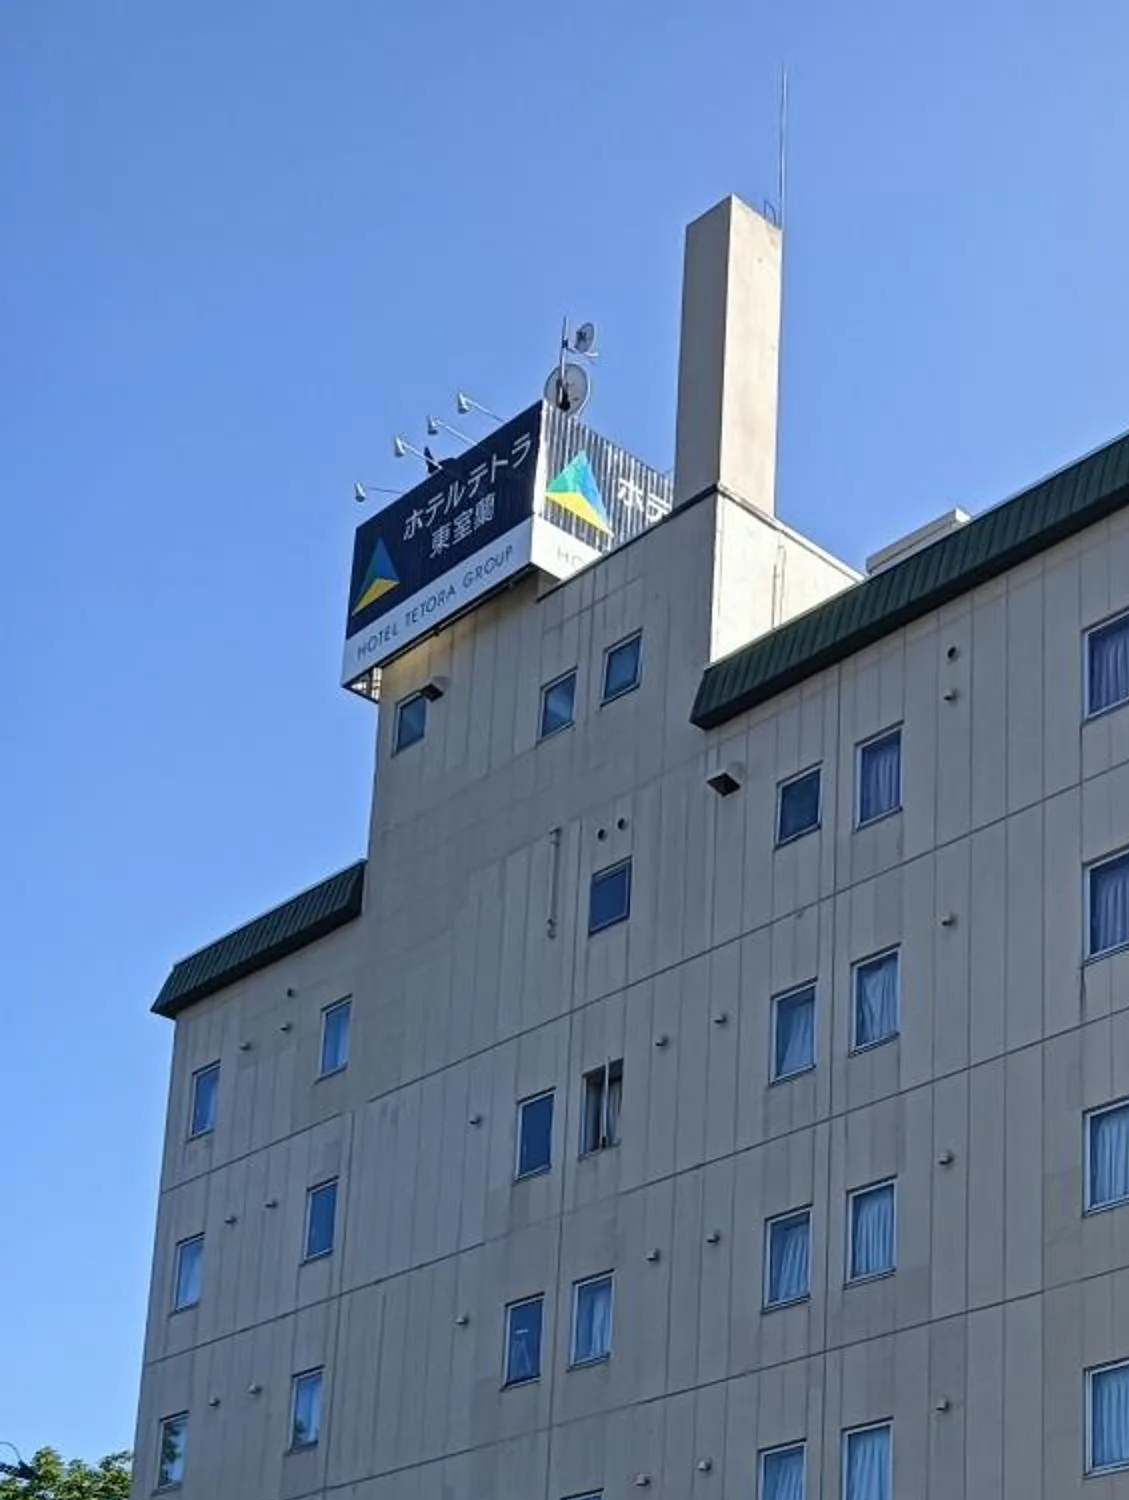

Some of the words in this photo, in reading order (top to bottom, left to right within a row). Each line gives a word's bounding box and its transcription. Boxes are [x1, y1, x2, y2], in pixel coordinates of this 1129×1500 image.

[403, 432, 531, 541] ホテルテトラ
[430, 491, 496, 559] 東室蘭
[357, 623, 399, 661] HOTEL
[404, 585, 456, 626] TETORA
[462, 544, 514, 589] GROUP
